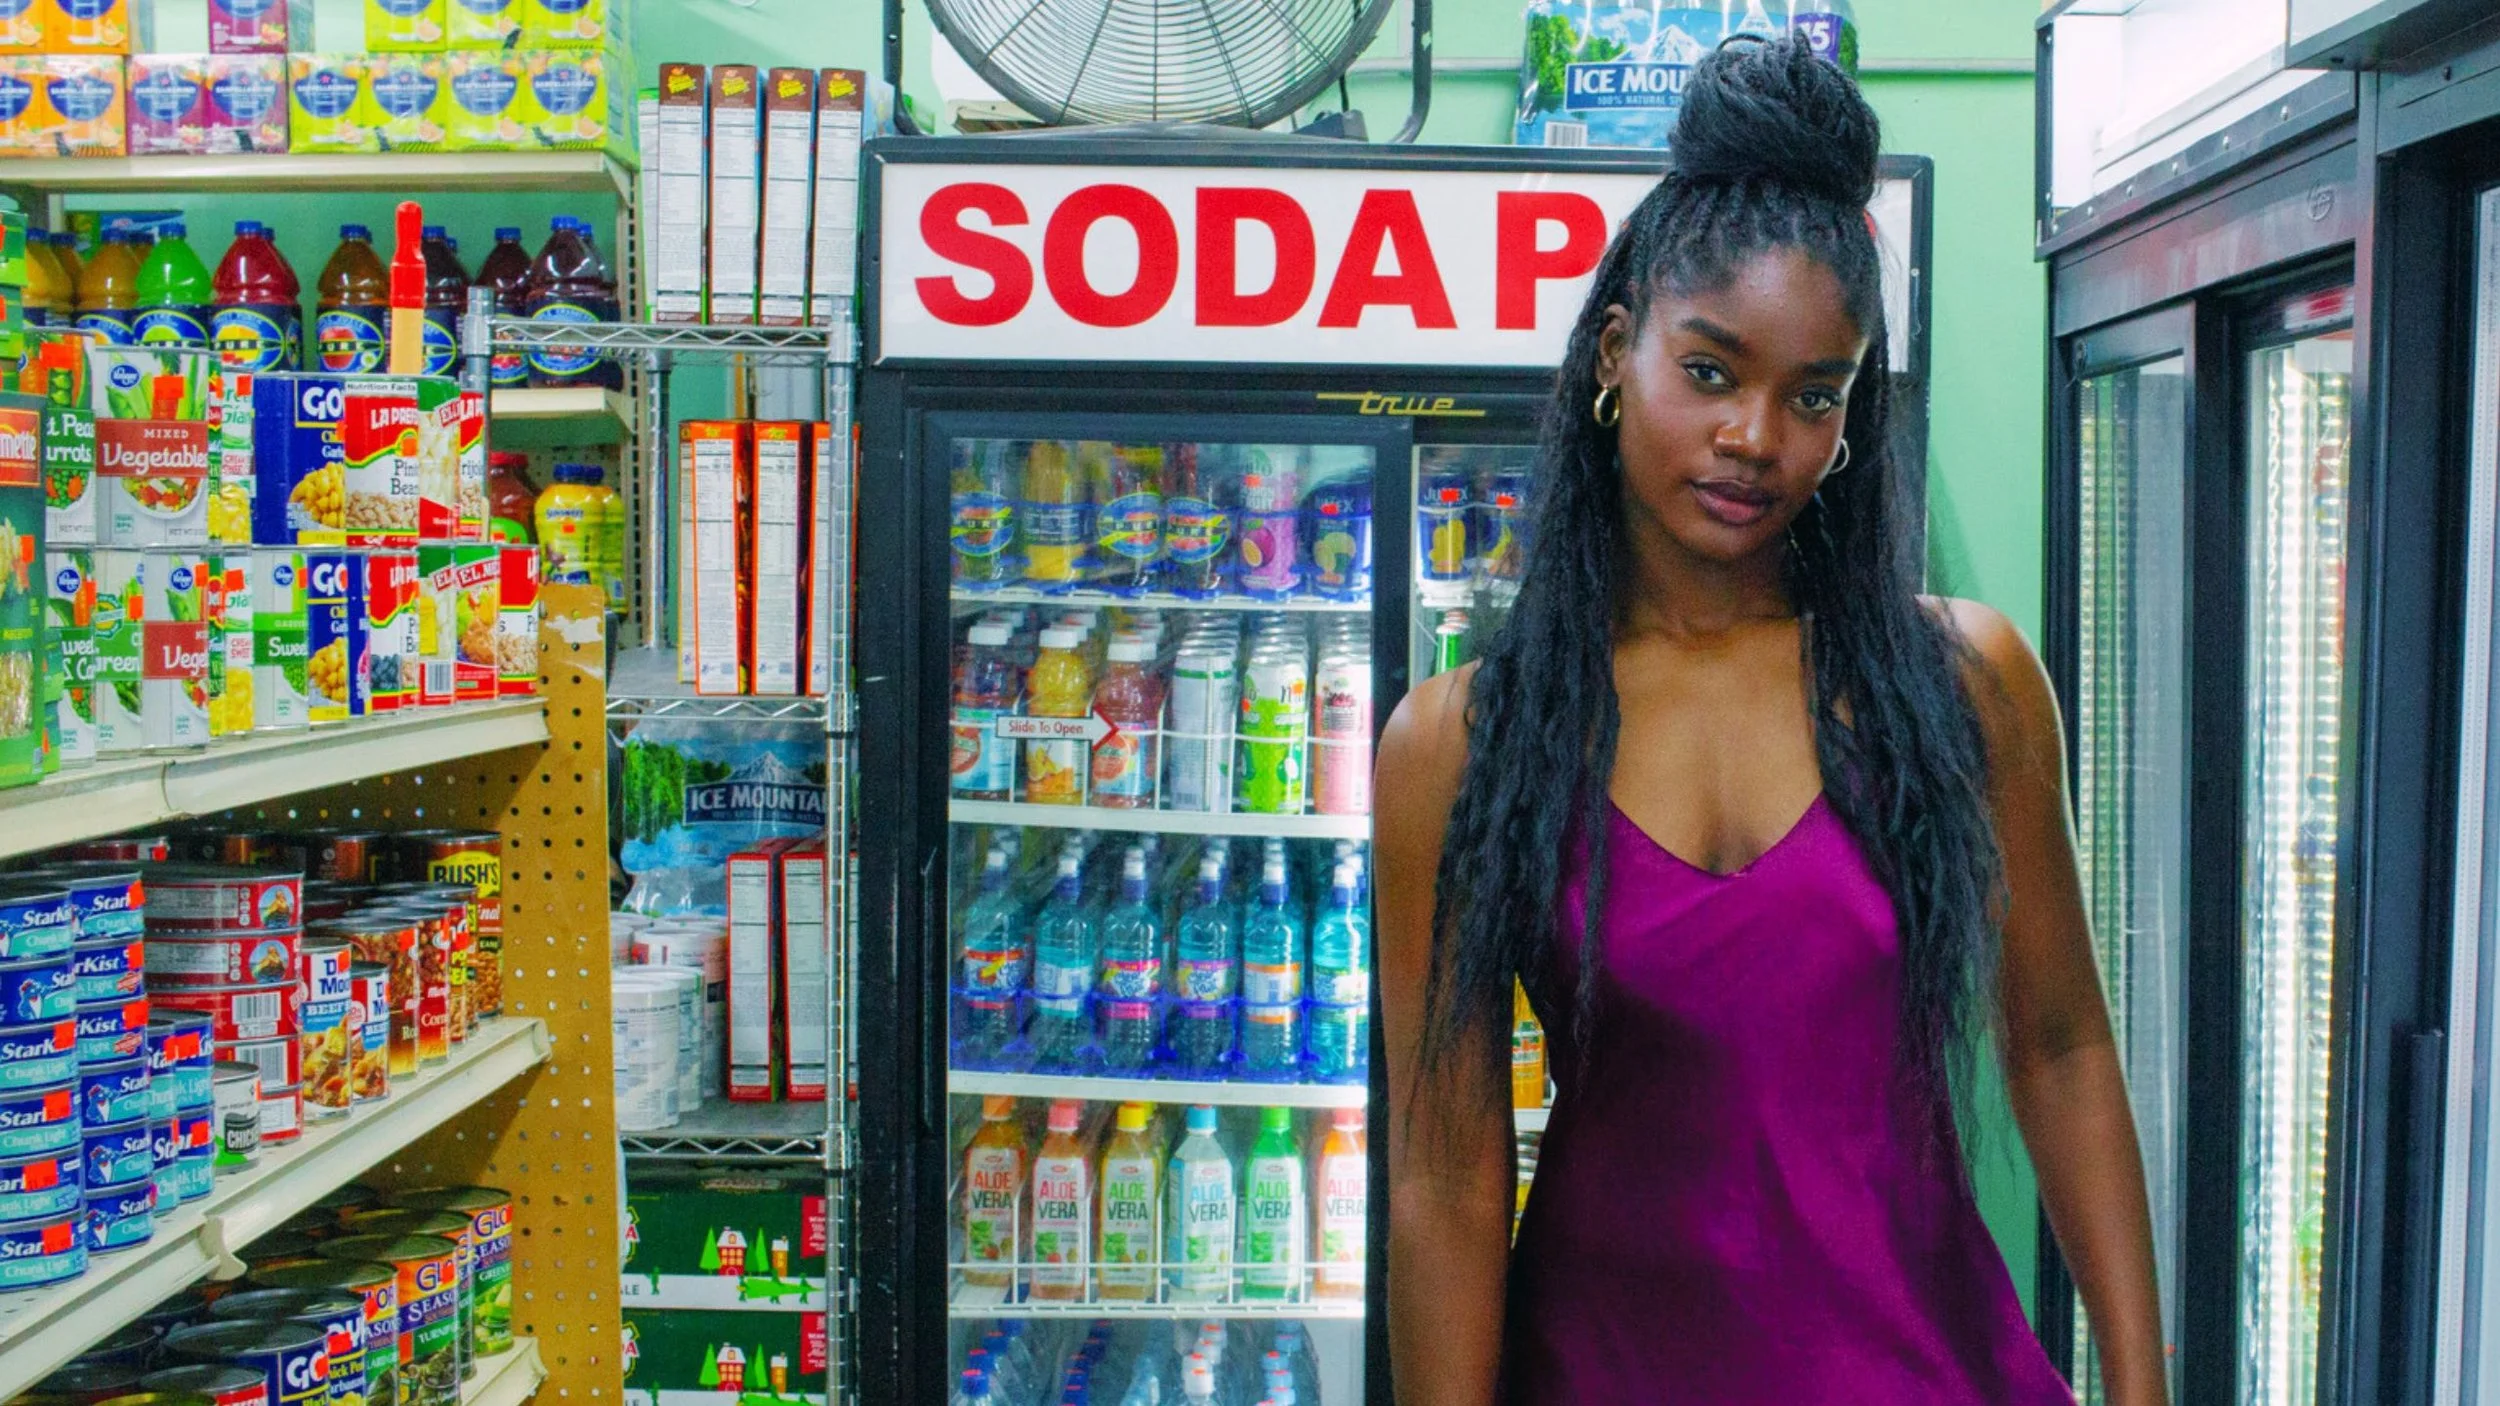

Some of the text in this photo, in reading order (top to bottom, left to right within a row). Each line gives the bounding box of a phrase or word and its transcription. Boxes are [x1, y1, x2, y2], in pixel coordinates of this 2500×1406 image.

[1573, 67, 1617, 95] ICE
[916, 183, 1456, 329] SODA
[347, 383, 416, 391] Nutrition Facts
[370, 408, 388, 430] LA
[143, 428, 189, 439] MIXED
[1008, 721, 1084, 735] Slide To Open
[691, 787, 726, 811] ICE
[433, 862, 499, 886] BUSH'S
[974, 1170, 1012, 1189] ALOE
[1327, 1179, 1364, 1197] ALOE
[1040, 1181, 1077, 1200] ALOE
[1109, 1181, 1147, 1200] ALOE
[1190, 1185, 1225, 1201] ALOE
[1256, 1180, 1291, 1199] ALOE
[972, 1190, 1013, 1209] VERA
[1326, 1198, 1365, 1216] VERA
[1038, 1201, 1078, 1219] VERA
[1107, 1201, 1148, 1220] VERA
[1188, 1201, 1228, 1222] VERA
[1252, 1200, 1292, 1219] VERA
[620, 1284, 640, 1296] LE
